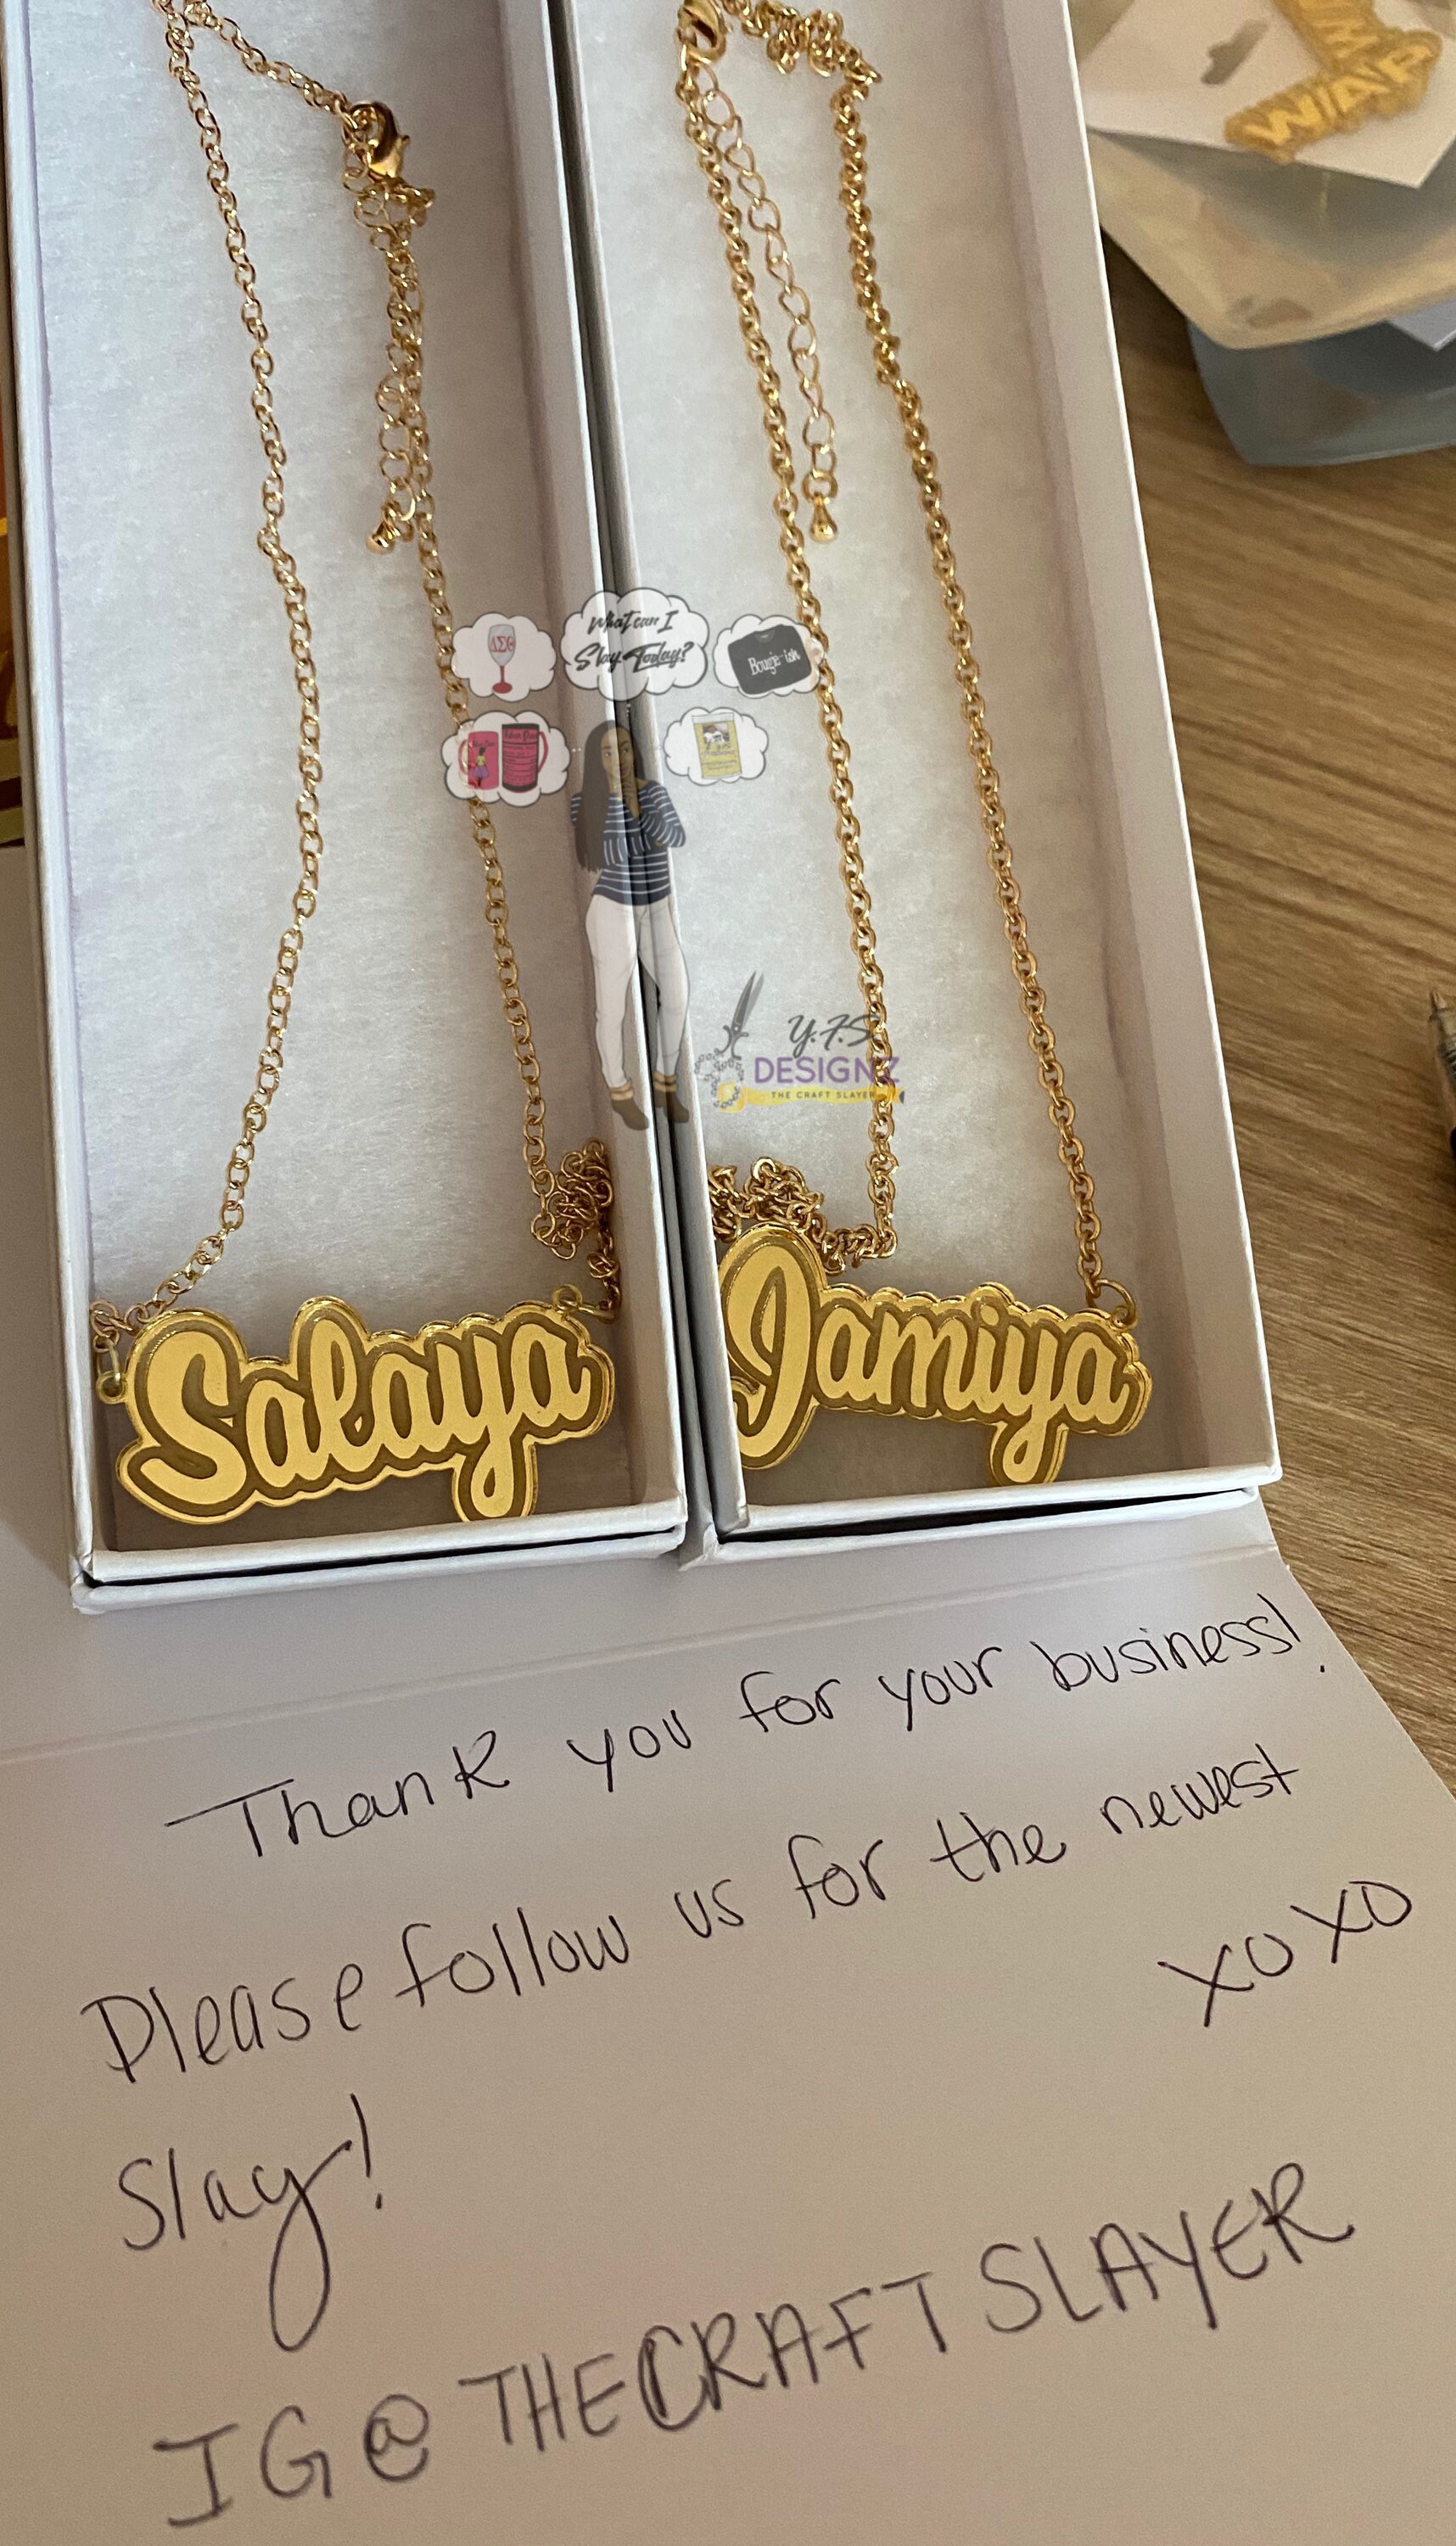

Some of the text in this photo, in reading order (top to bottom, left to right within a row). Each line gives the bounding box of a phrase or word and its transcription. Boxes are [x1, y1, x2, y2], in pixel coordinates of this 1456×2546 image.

[127, 1307, 601, 1523] Salaya
[725, 1241, 1137, 1485] Jamiya
[163, 1592, 1325, 1858] Thank you for your business!
[79, 1742, 1300, 2083] Please follow us for the newest
[118, 2092, 384, 2353] Slay!
